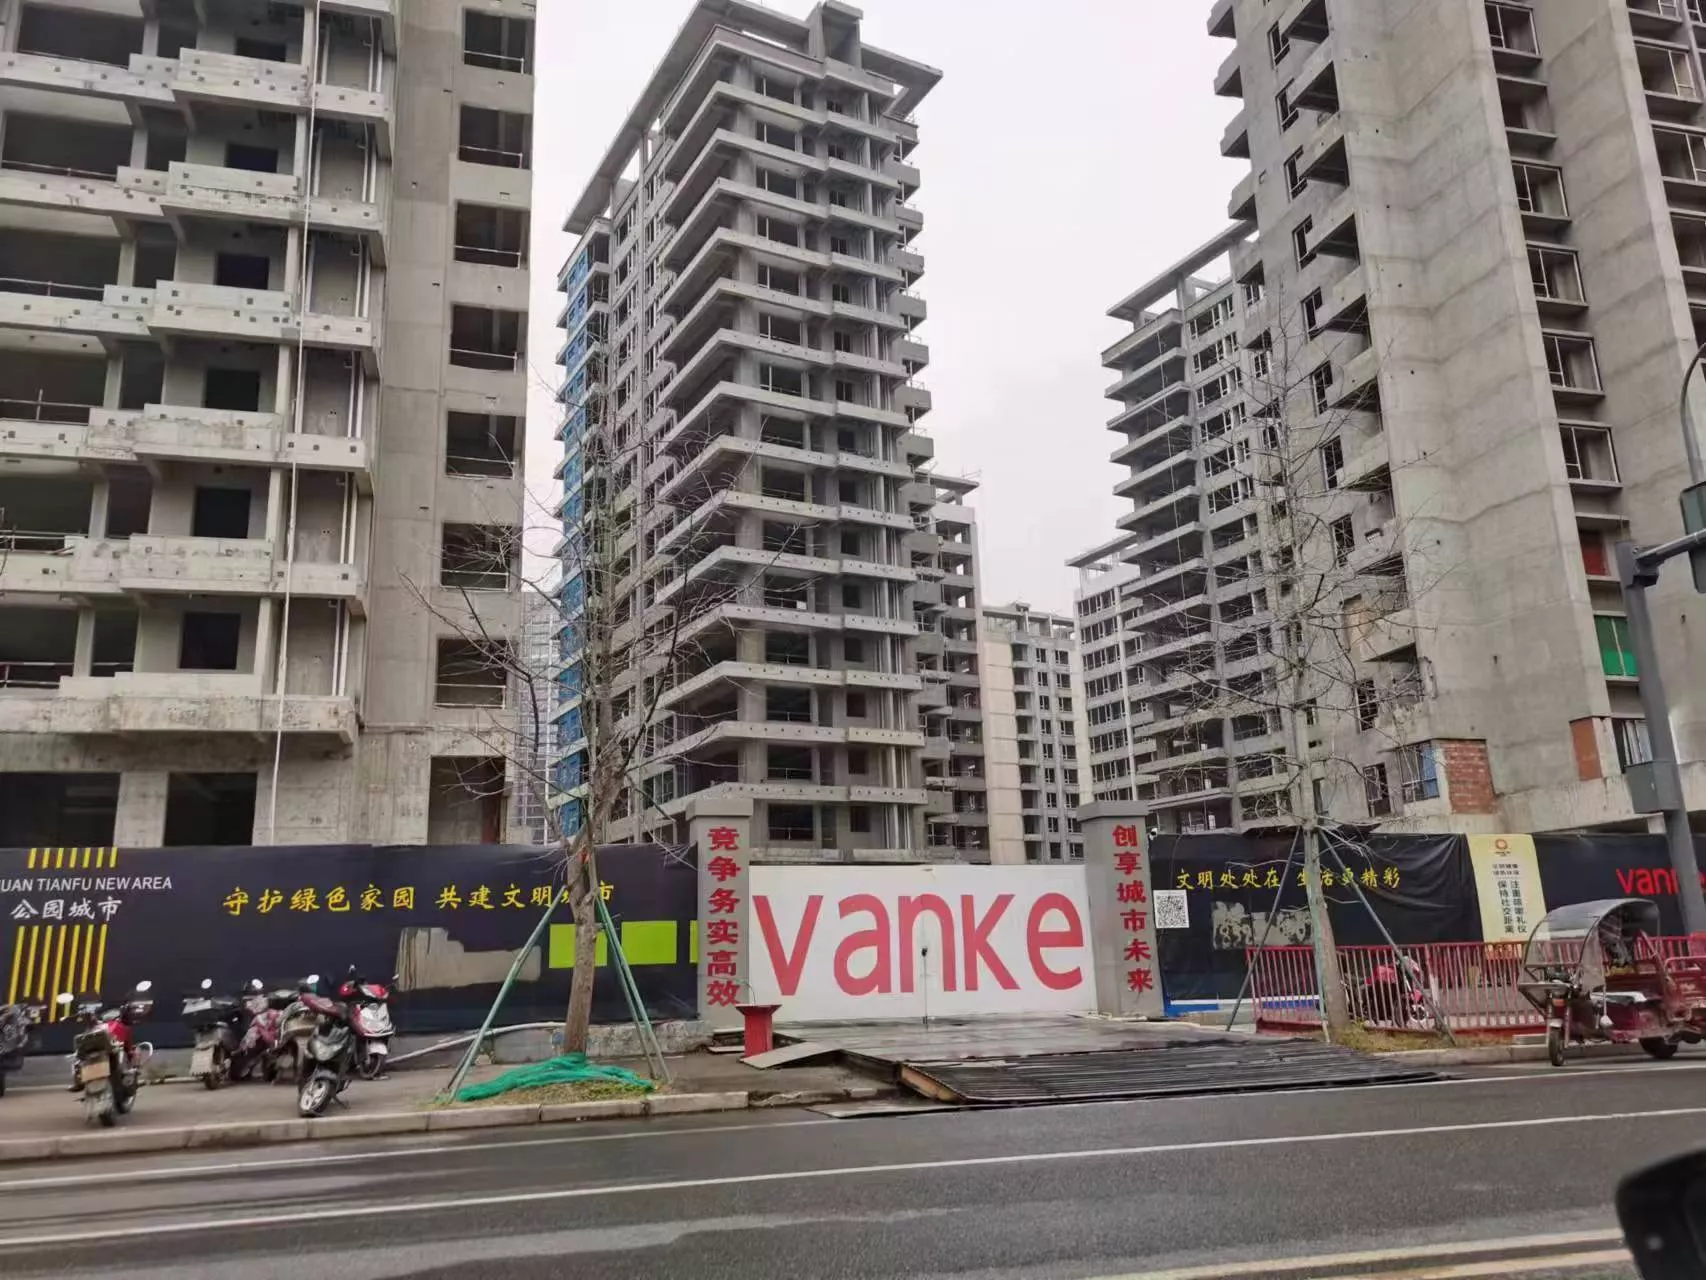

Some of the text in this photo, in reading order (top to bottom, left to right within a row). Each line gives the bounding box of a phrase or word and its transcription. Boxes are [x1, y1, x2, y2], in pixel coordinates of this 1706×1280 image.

[0, 876, 173, 893] UAN TIANFU NEW AREA
[1176, 867, 1280, 890] 文明处处在
[10, 895, 123, 922] 公园城市
[222, 880, 615, 917] 守护绿色家园 共建文明市
[1111, 824, 1153, 993] 创享城市未来
[707, 826, 741, 1007] 竞争务实高效
